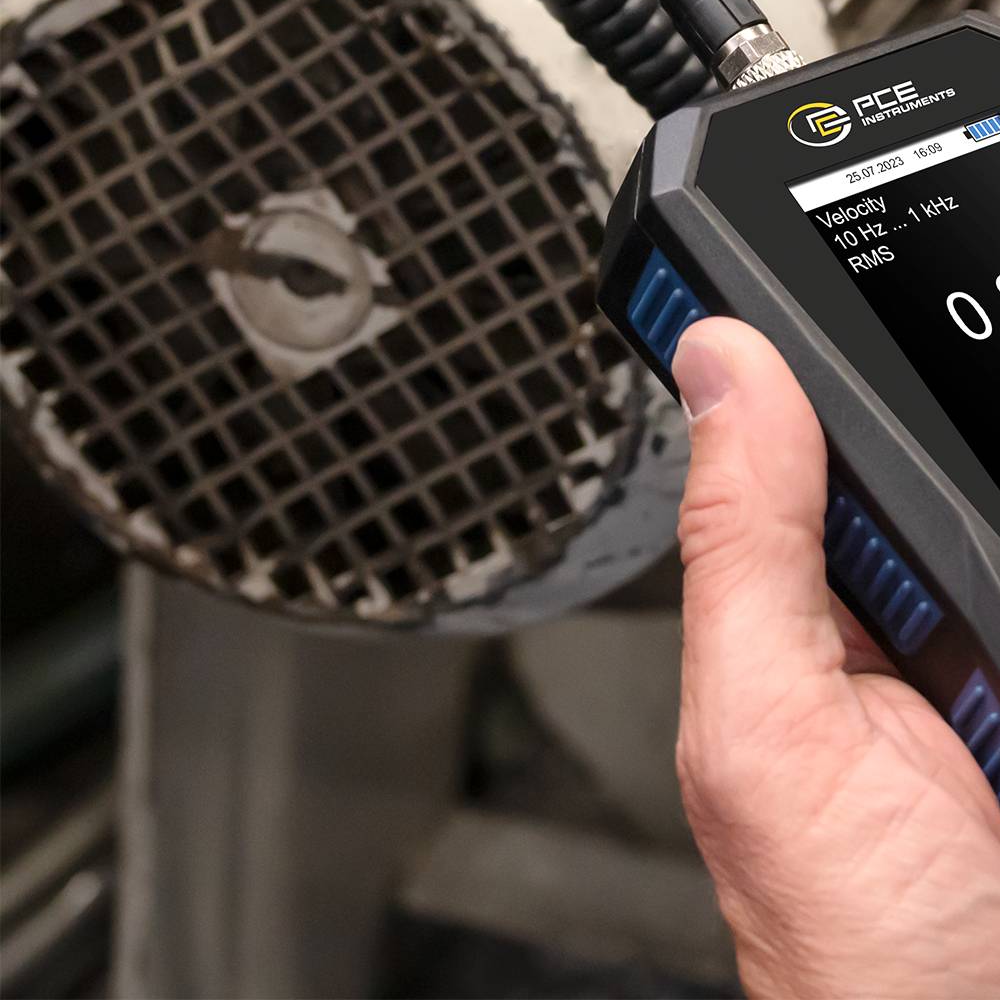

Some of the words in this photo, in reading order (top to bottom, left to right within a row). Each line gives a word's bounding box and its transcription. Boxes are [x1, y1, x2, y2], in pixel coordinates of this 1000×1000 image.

[852, 80, 919, 117] PCE
[861, 87, 956, 126] INSTRUMENTS
[846, 156, 905, 184] 25.07.2023
[912, 142, 943, 160] 16:09
[816, 196, 887, 229] Velocity
[834, 230, 858, 251] 10
[857, 221, 888, 242] Hz
[908, 206, 922, 225] 1
[922, 194, 960, 219] kHz
[847, 245, 896, 275] RMS
